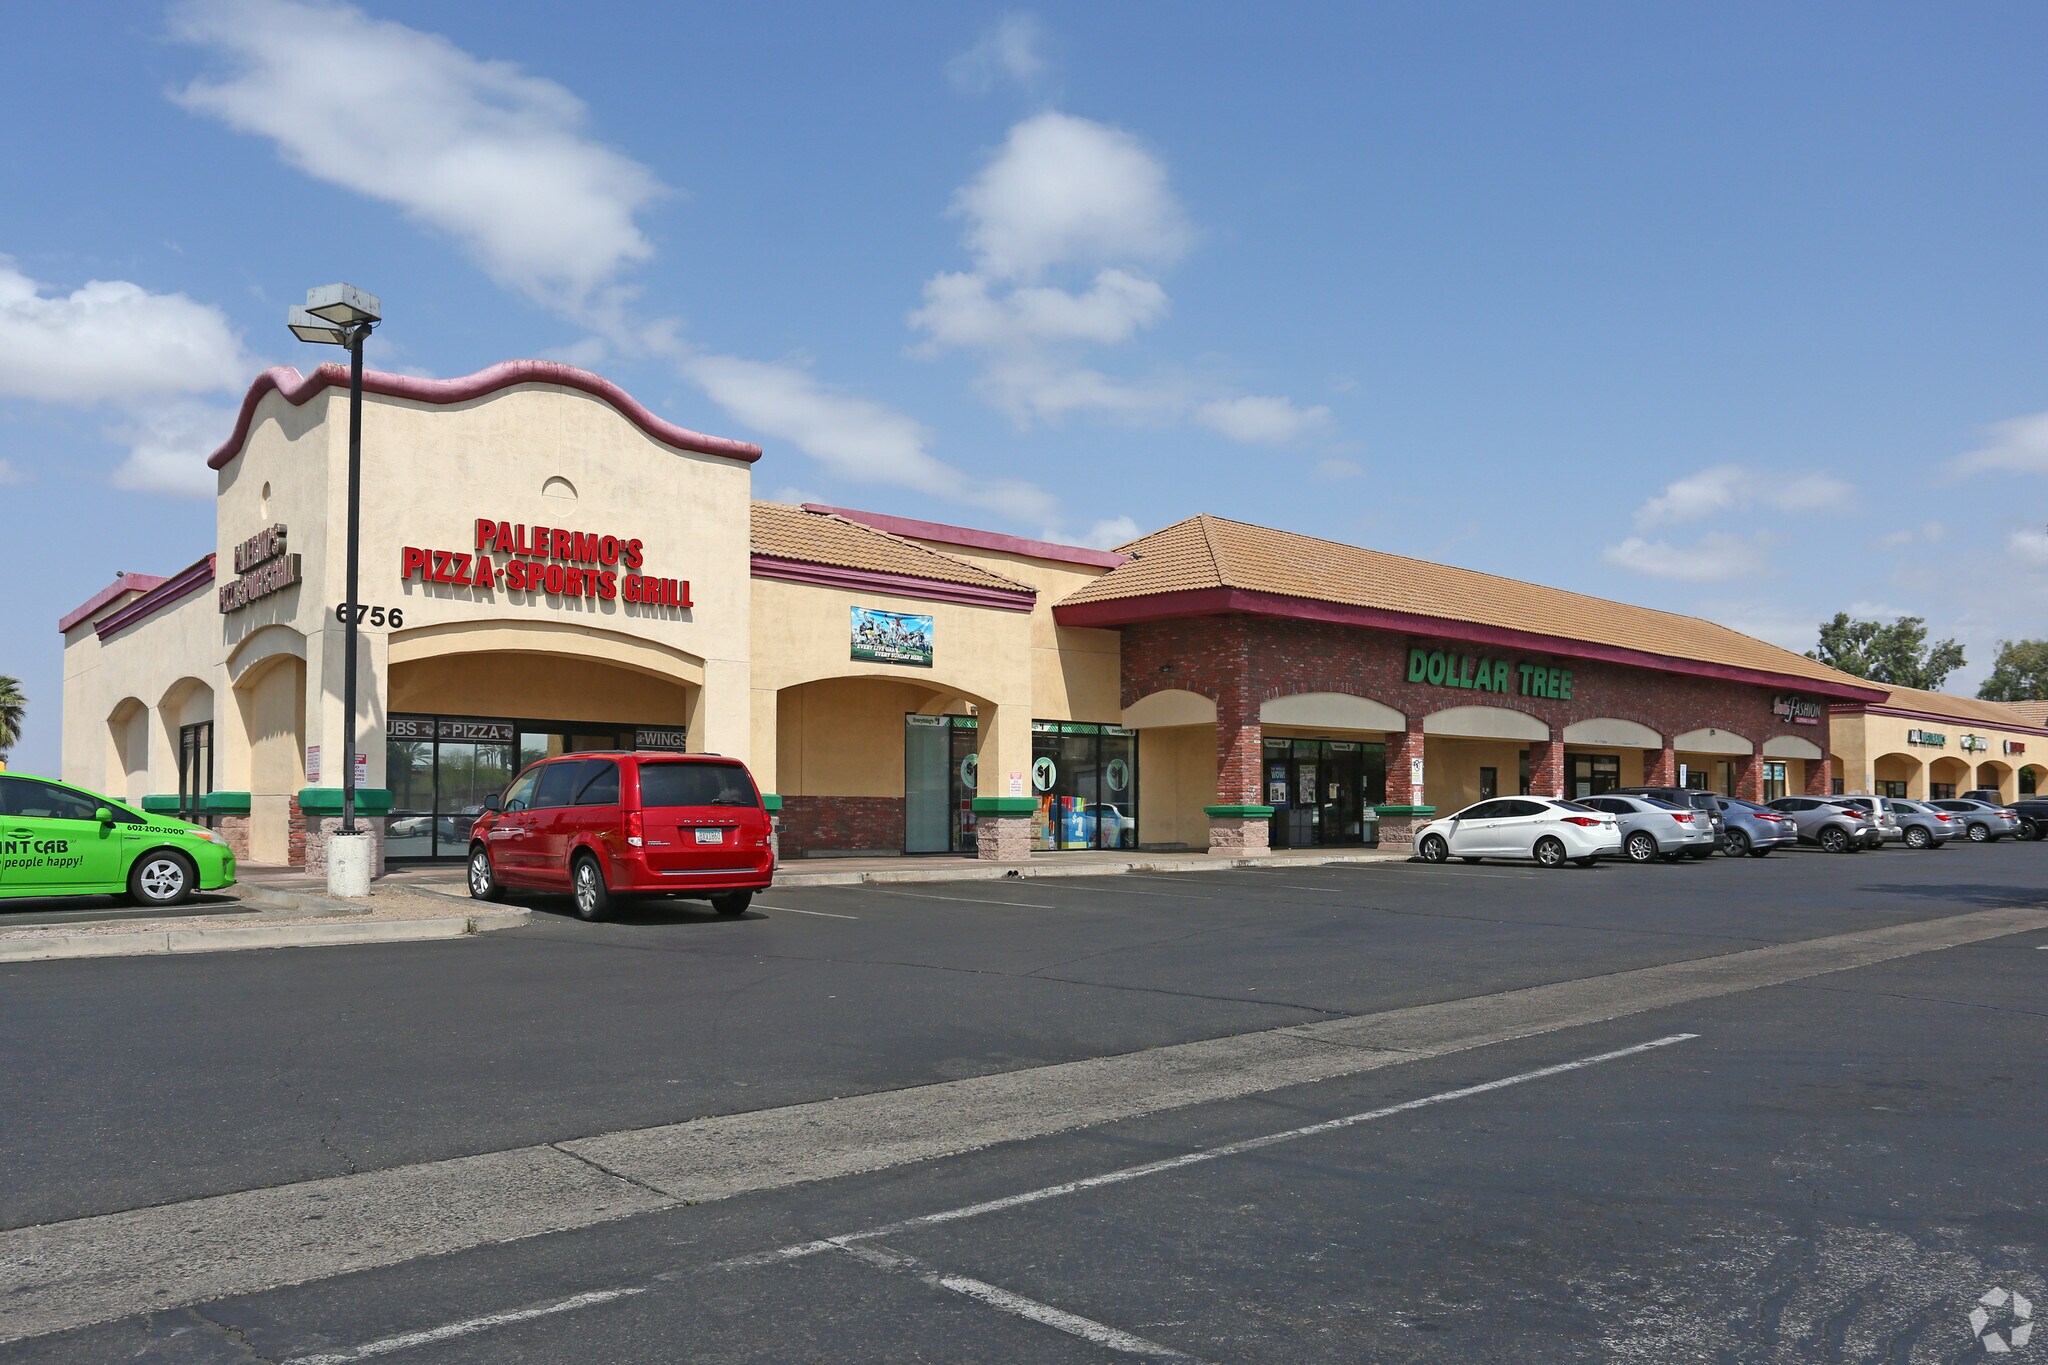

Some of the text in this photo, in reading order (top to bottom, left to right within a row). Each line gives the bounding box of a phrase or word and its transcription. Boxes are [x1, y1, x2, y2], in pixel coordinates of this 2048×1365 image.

[475, 518, 643, 569] PALERMO'S
[401, 546, 694, 608] PIZZA SPORTS GRILL
[336, 603, 403, 628] 6756
[1408, 648, 1573, 700] DOLLAR TREE
[452, 723, 500, 739] PIZZA
[644, 732, 686, 747] WINGS
[1037, 764, 1050, 790] $1
[1111, 765, 1123, 790] $1
[127, 824, 185, 835] 602-200-2000
[1072, 814, 1084, 837] $1
[34, 840, 69, 855] CAB
[4, 856, 43, 870] people
[46, 855, 84, 868] happy!
